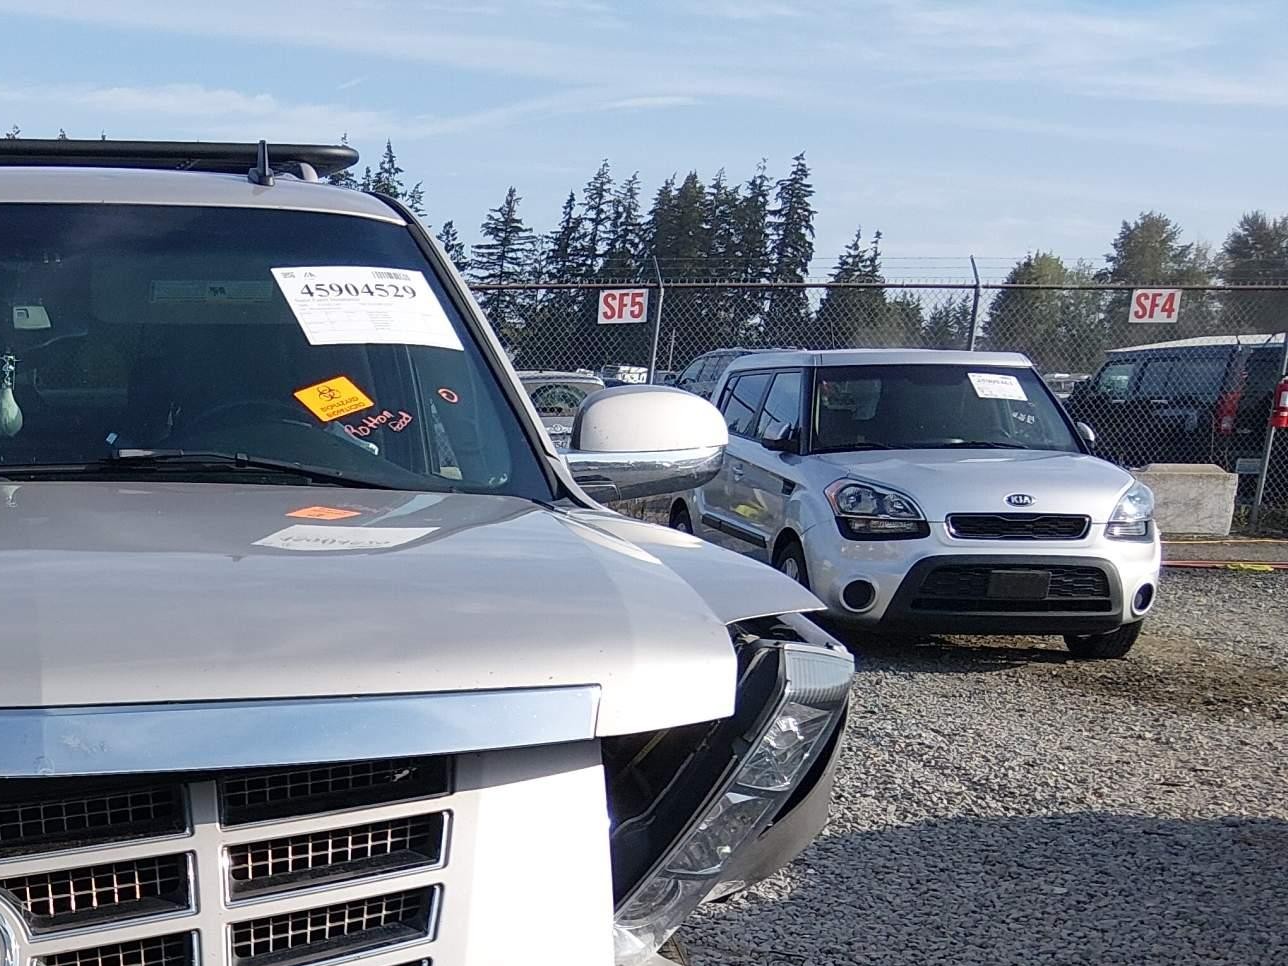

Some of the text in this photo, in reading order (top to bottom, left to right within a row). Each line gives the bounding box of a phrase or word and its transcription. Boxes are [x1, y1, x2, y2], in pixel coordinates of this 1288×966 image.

[300, 283, 417, 300] 45904529
[602, 292, 644, 320] SF5
[1134, 292, 1176, 319] SF4
[1010, 495, 1031, 504] KIA
